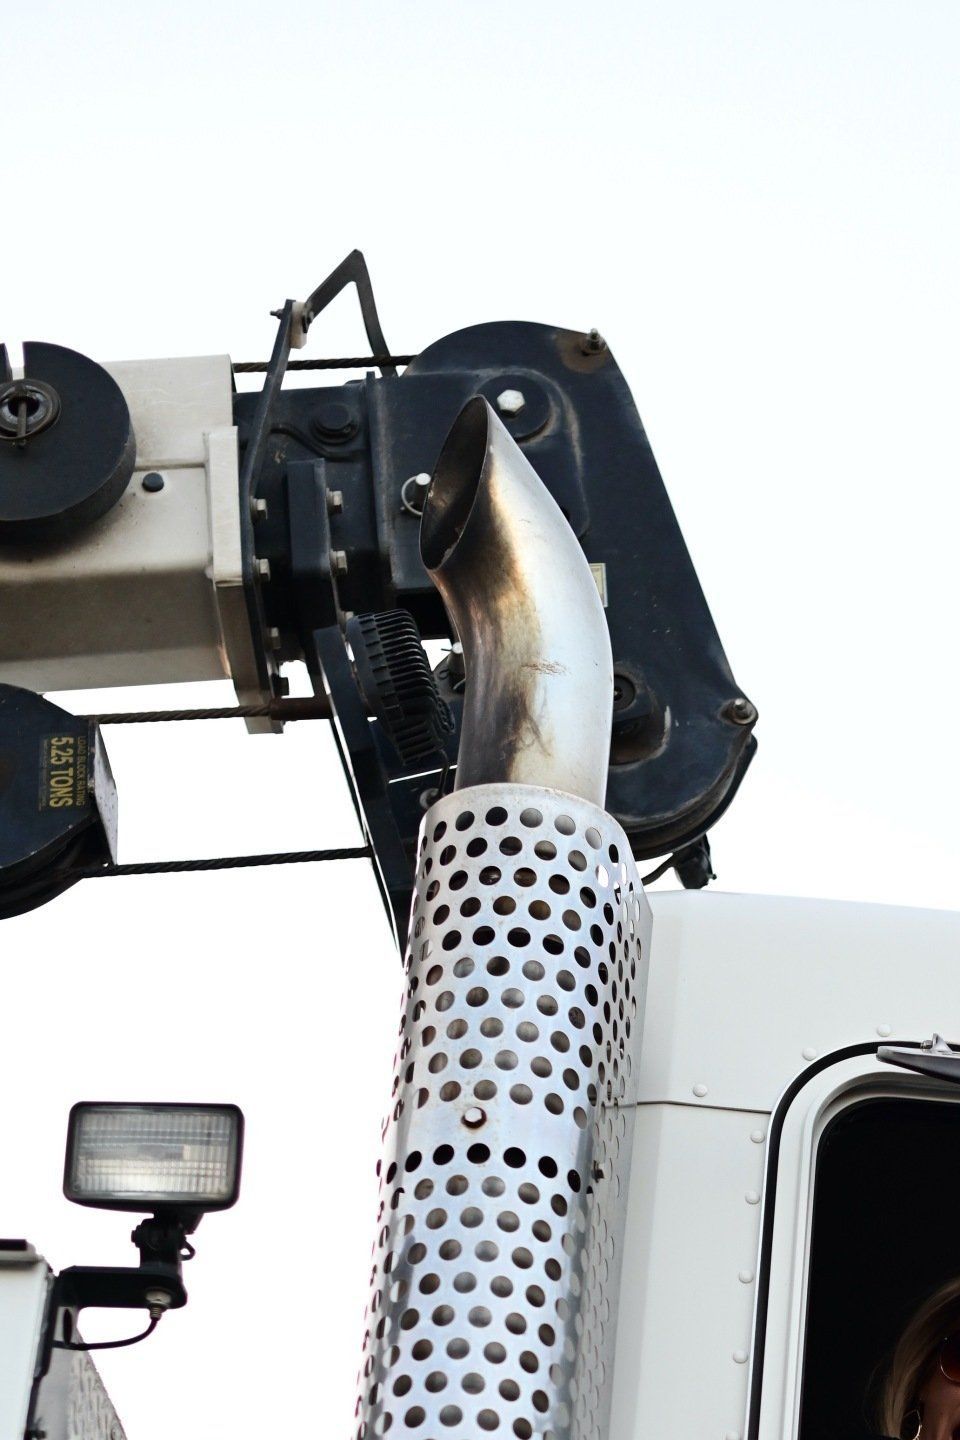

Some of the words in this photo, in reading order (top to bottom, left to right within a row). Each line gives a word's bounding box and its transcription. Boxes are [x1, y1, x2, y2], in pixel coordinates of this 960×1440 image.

[50, 736, 74, 765] 5.25
[77, 735, 87, 755] LOAD
[76, 756, 87, 779] BLOCK
[49, 767, 74, 808] TONS
[75, 780, 86, 806] RATING
